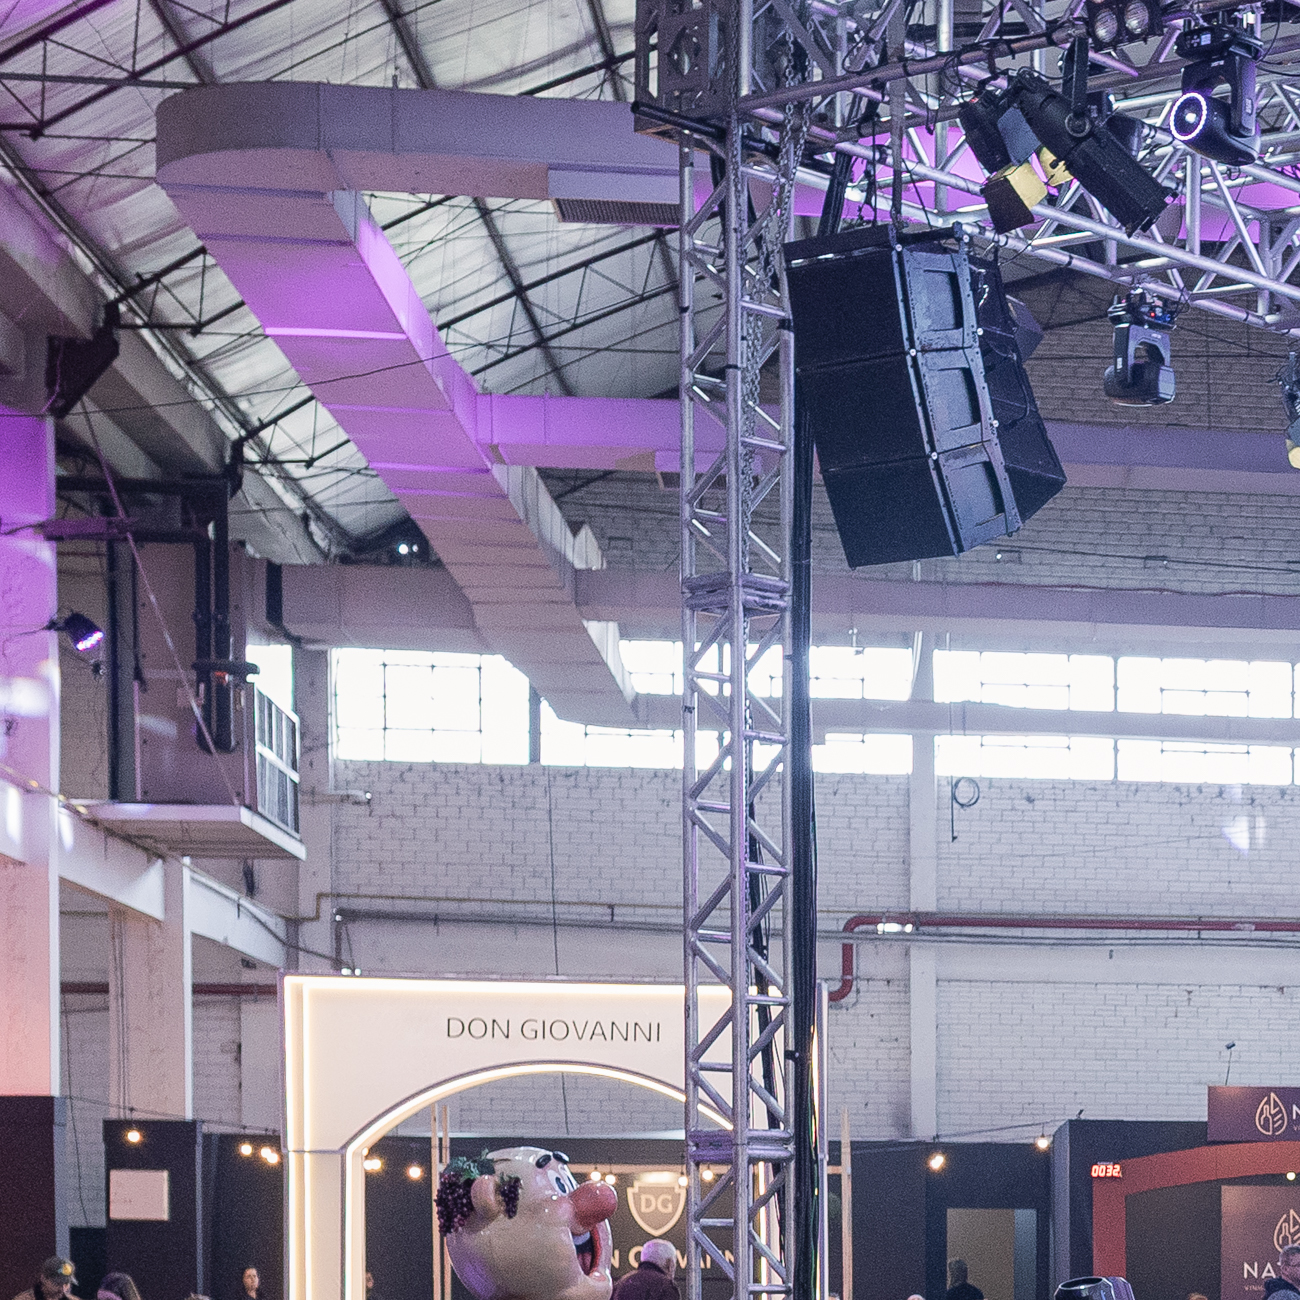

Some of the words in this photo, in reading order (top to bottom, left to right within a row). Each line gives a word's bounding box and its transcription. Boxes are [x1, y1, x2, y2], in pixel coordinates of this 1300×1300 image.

[447, 1017, 510, 1040] DON
[520, 1018, 661, 1043] GIOVANNI
[1091, 1164, 1121, 1177] 0032
[640, 1194, 674, 1213] DG
